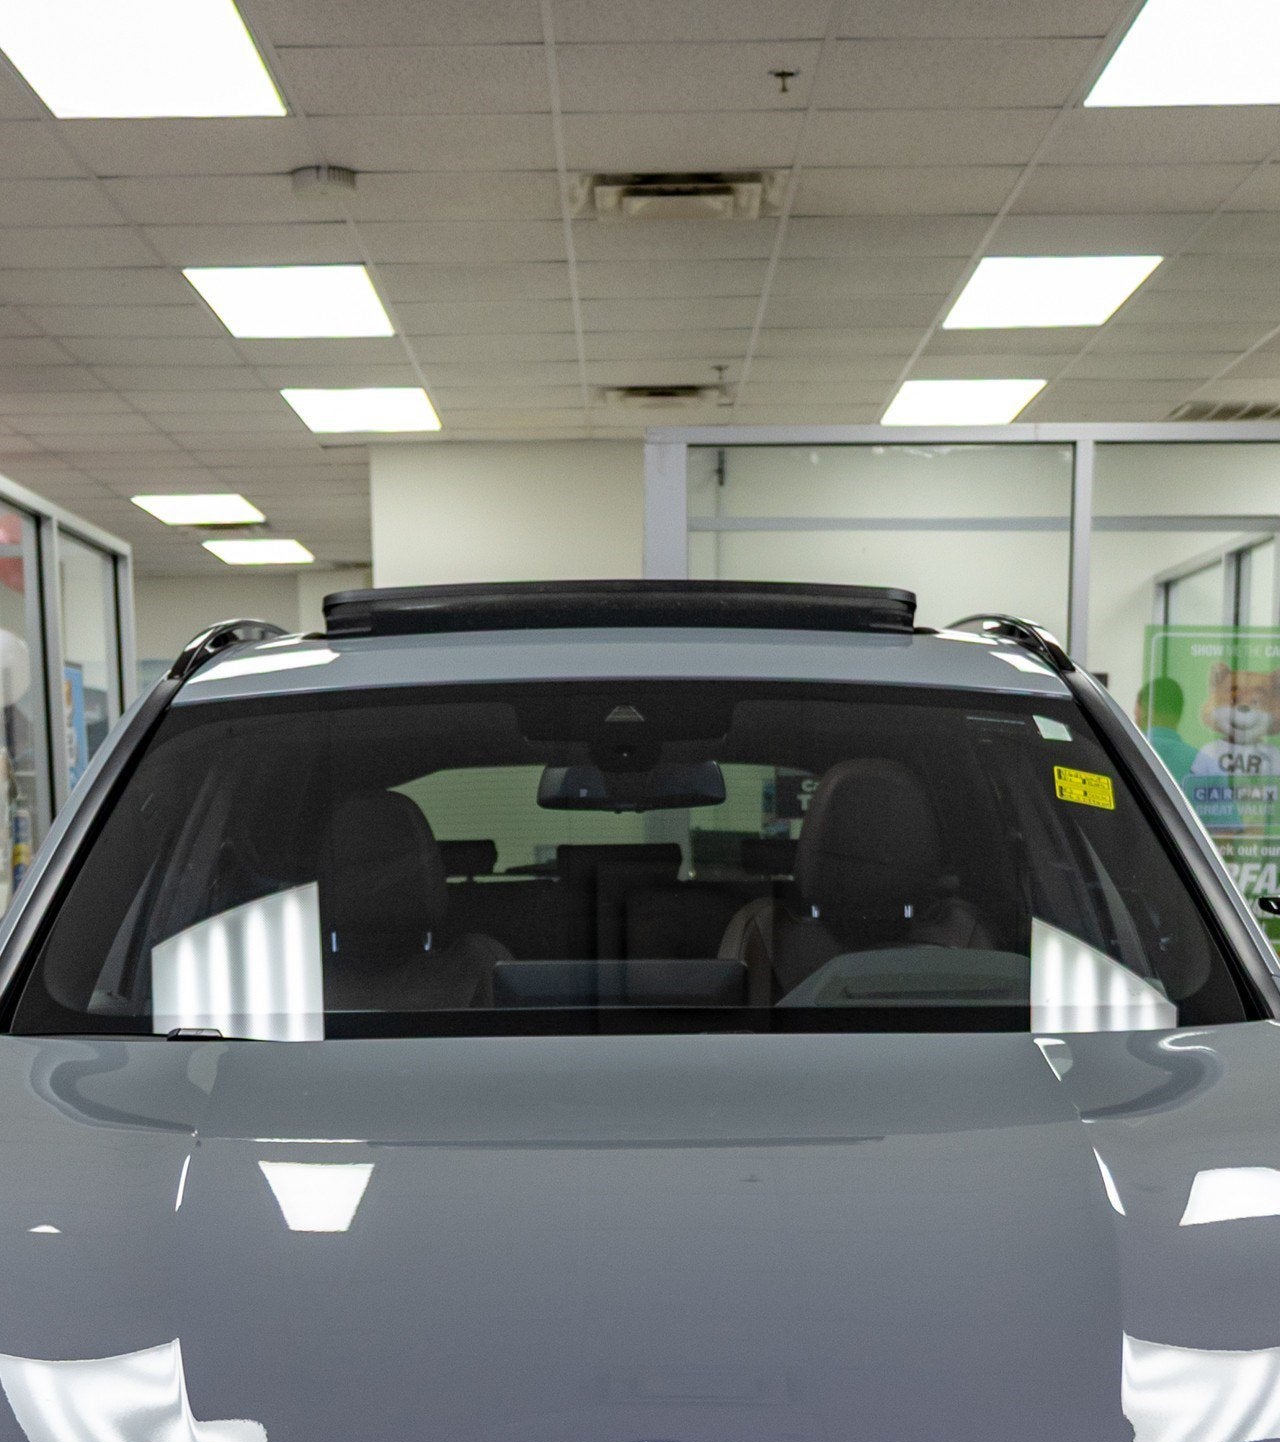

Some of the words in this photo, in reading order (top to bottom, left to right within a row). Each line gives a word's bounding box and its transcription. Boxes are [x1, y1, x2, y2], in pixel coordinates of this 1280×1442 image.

[1219, 753, 1262, 774] CAR
[1194, 786, 1278, 801] CARFAX
[1237, 844, 1258, 856] out
